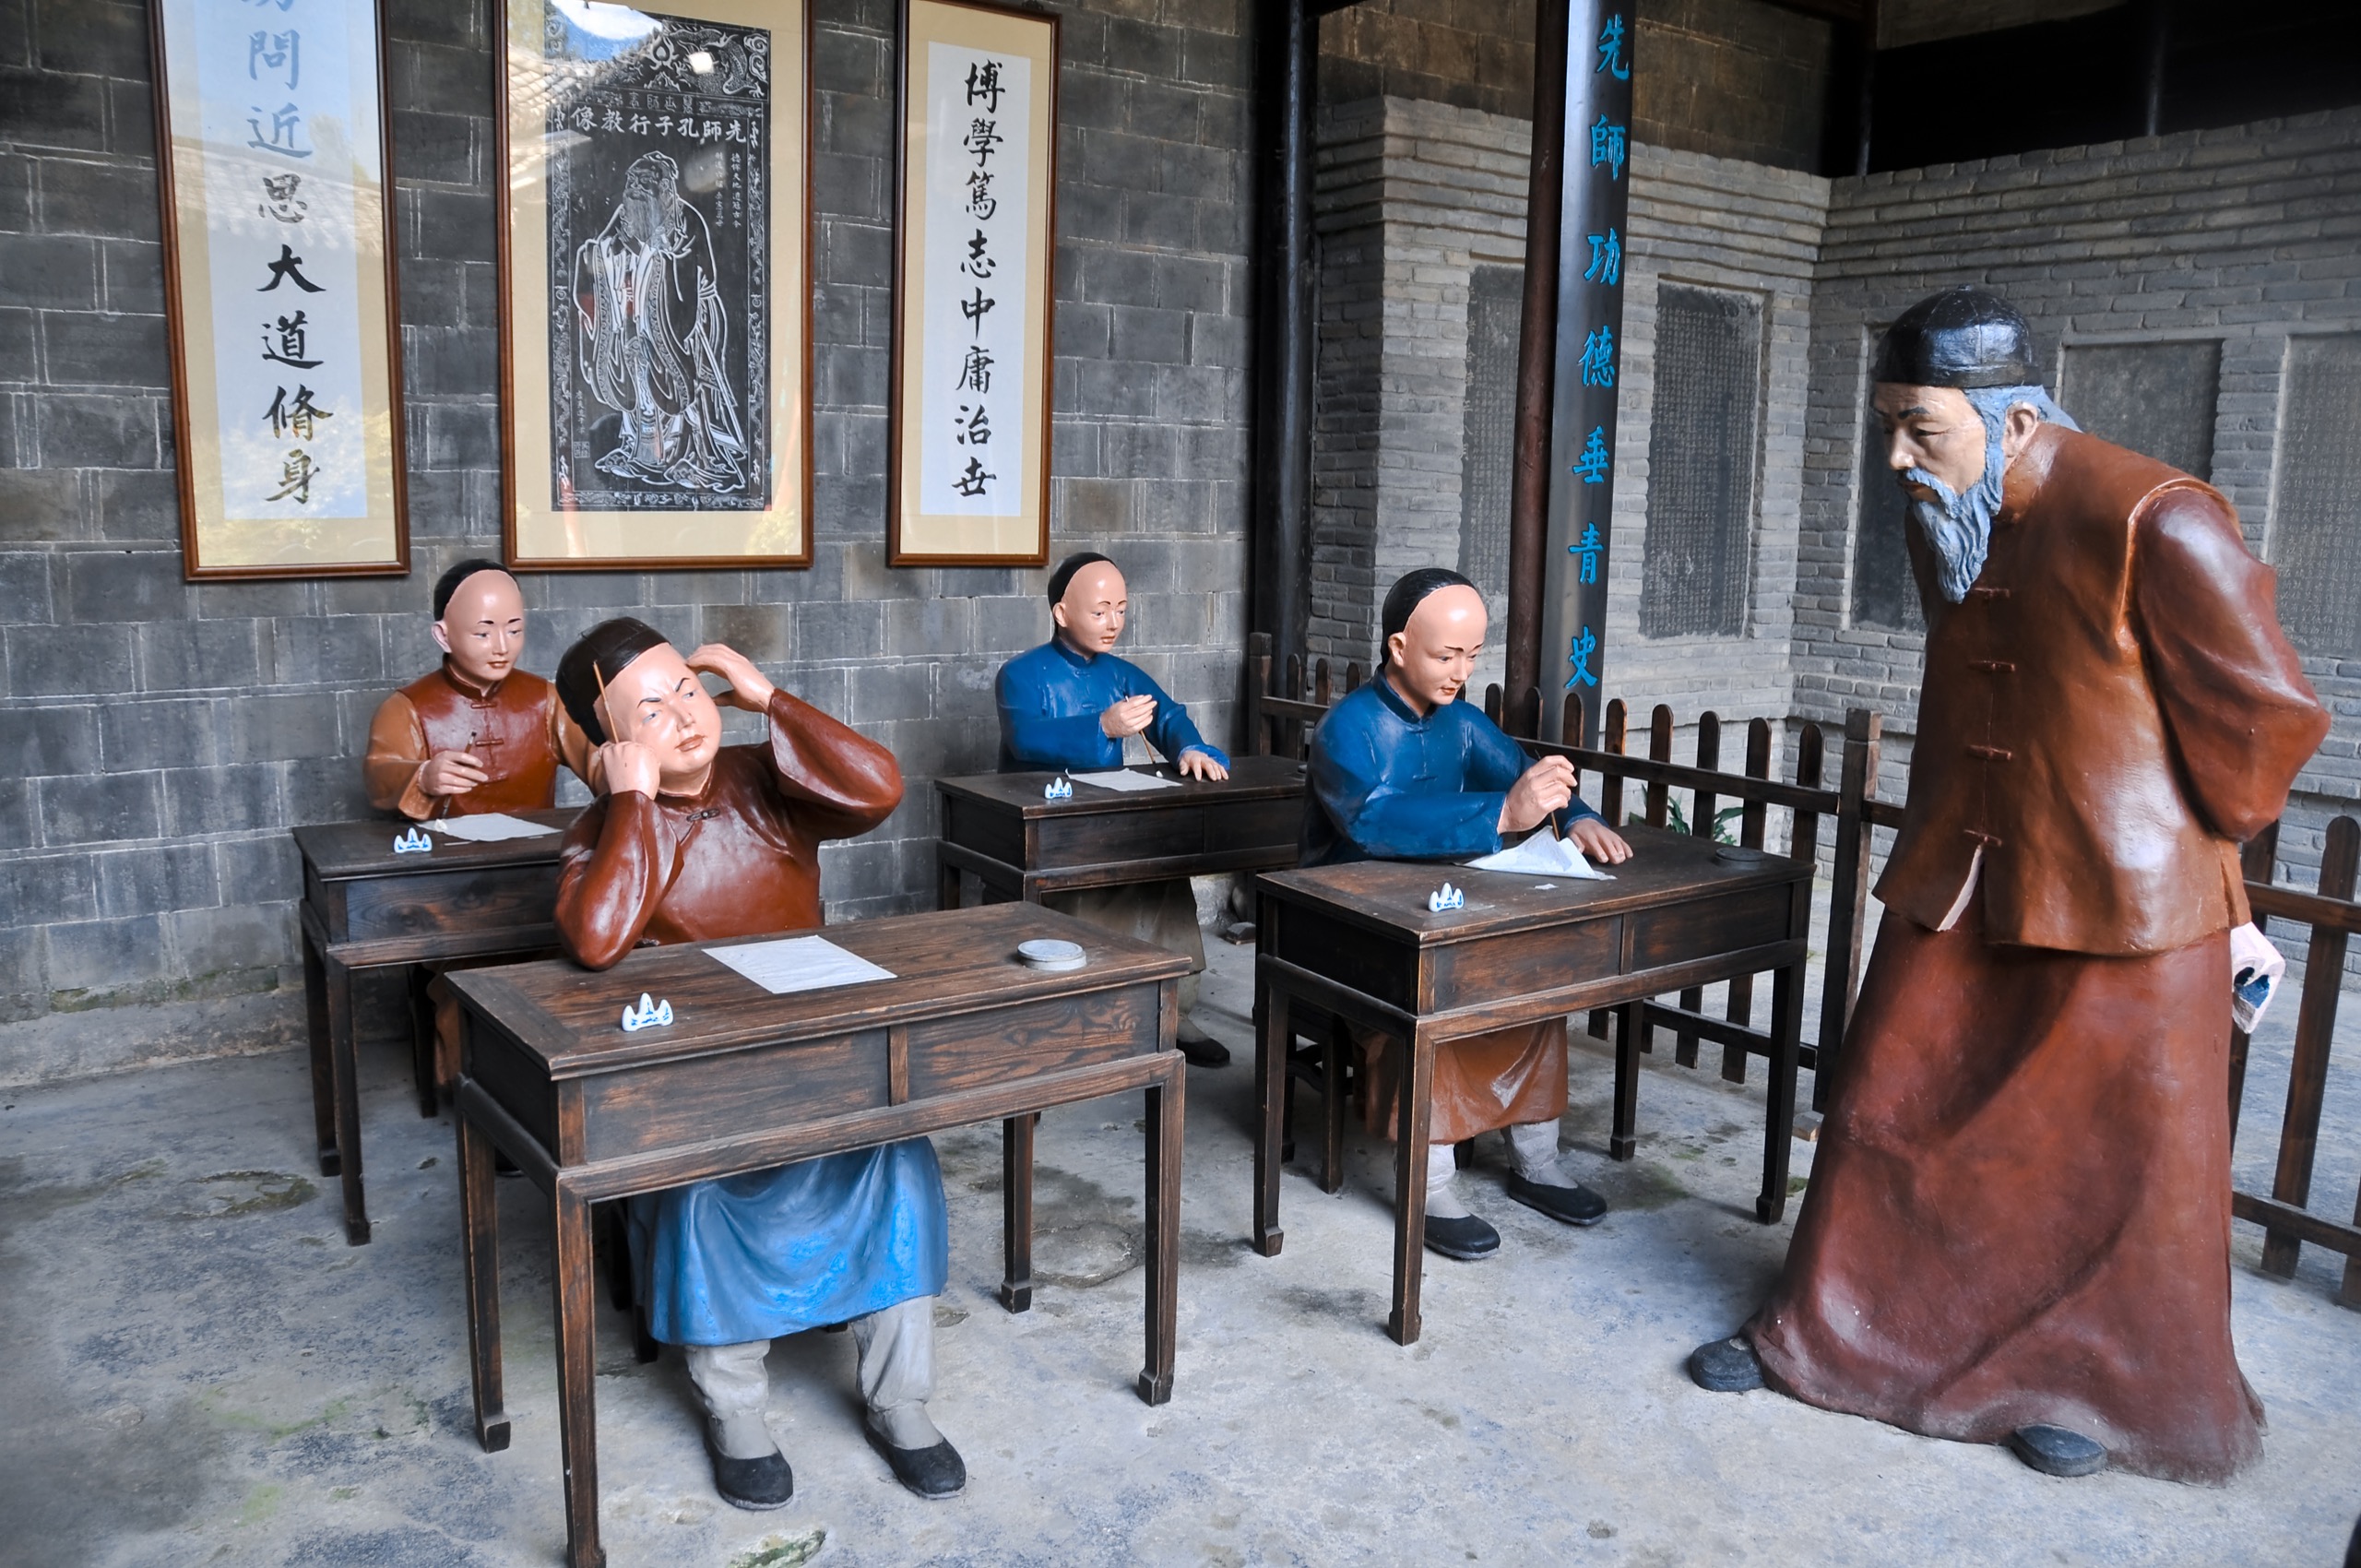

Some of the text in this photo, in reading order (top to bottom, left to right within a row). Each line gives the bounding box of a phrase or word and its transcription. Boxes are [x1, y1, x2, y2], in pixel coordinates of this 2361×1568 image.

[569, 104, 747, 143] 先師孔子行教像
[1564, 13, 1630, 689] 先師功德垂青史
